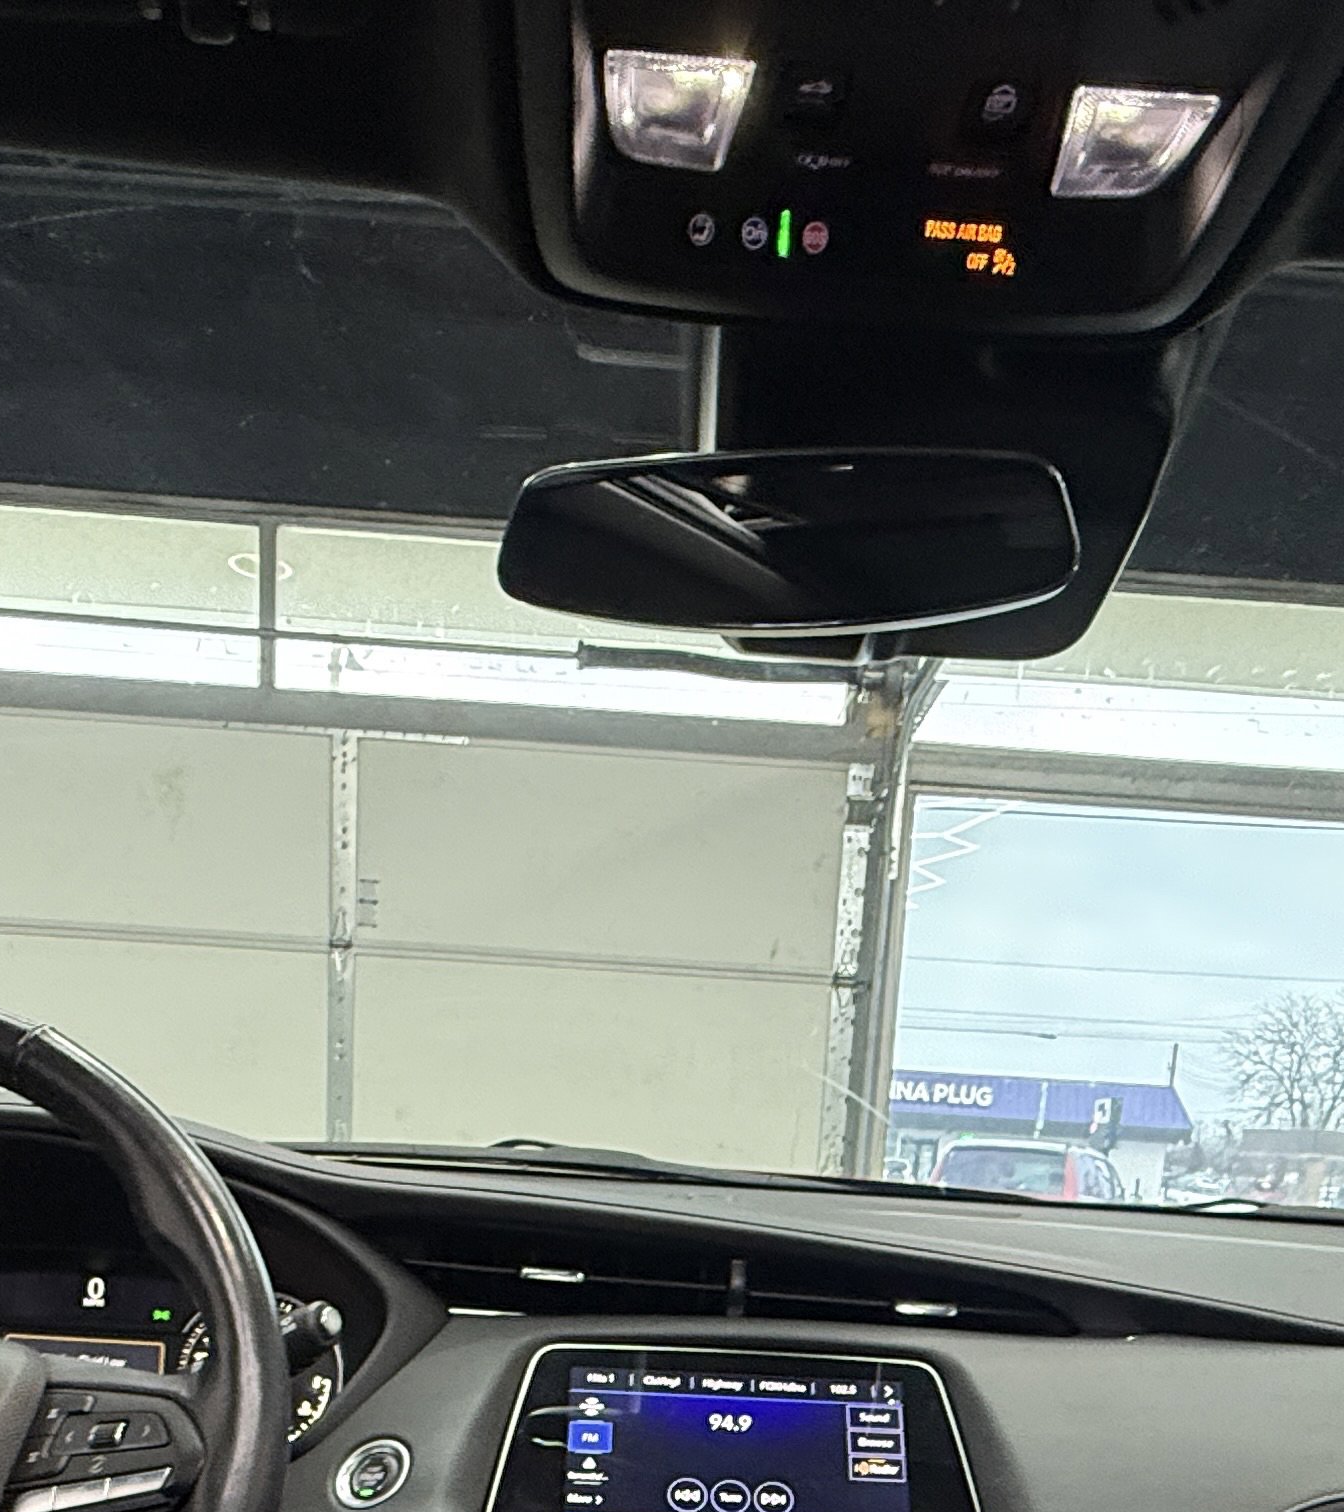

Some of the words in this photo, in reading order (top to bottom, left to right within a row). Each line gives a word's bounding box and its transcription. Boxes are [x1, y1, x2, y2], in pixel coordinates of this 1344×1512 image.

[924, 219, 956, 240] PASS
[966, 252, 989, 271] OFF
[933, 1083, 993, 1107] PLUG
[87, 1276, 105, 1300] 0
[708, 1413, 753, 1432] 94.9
